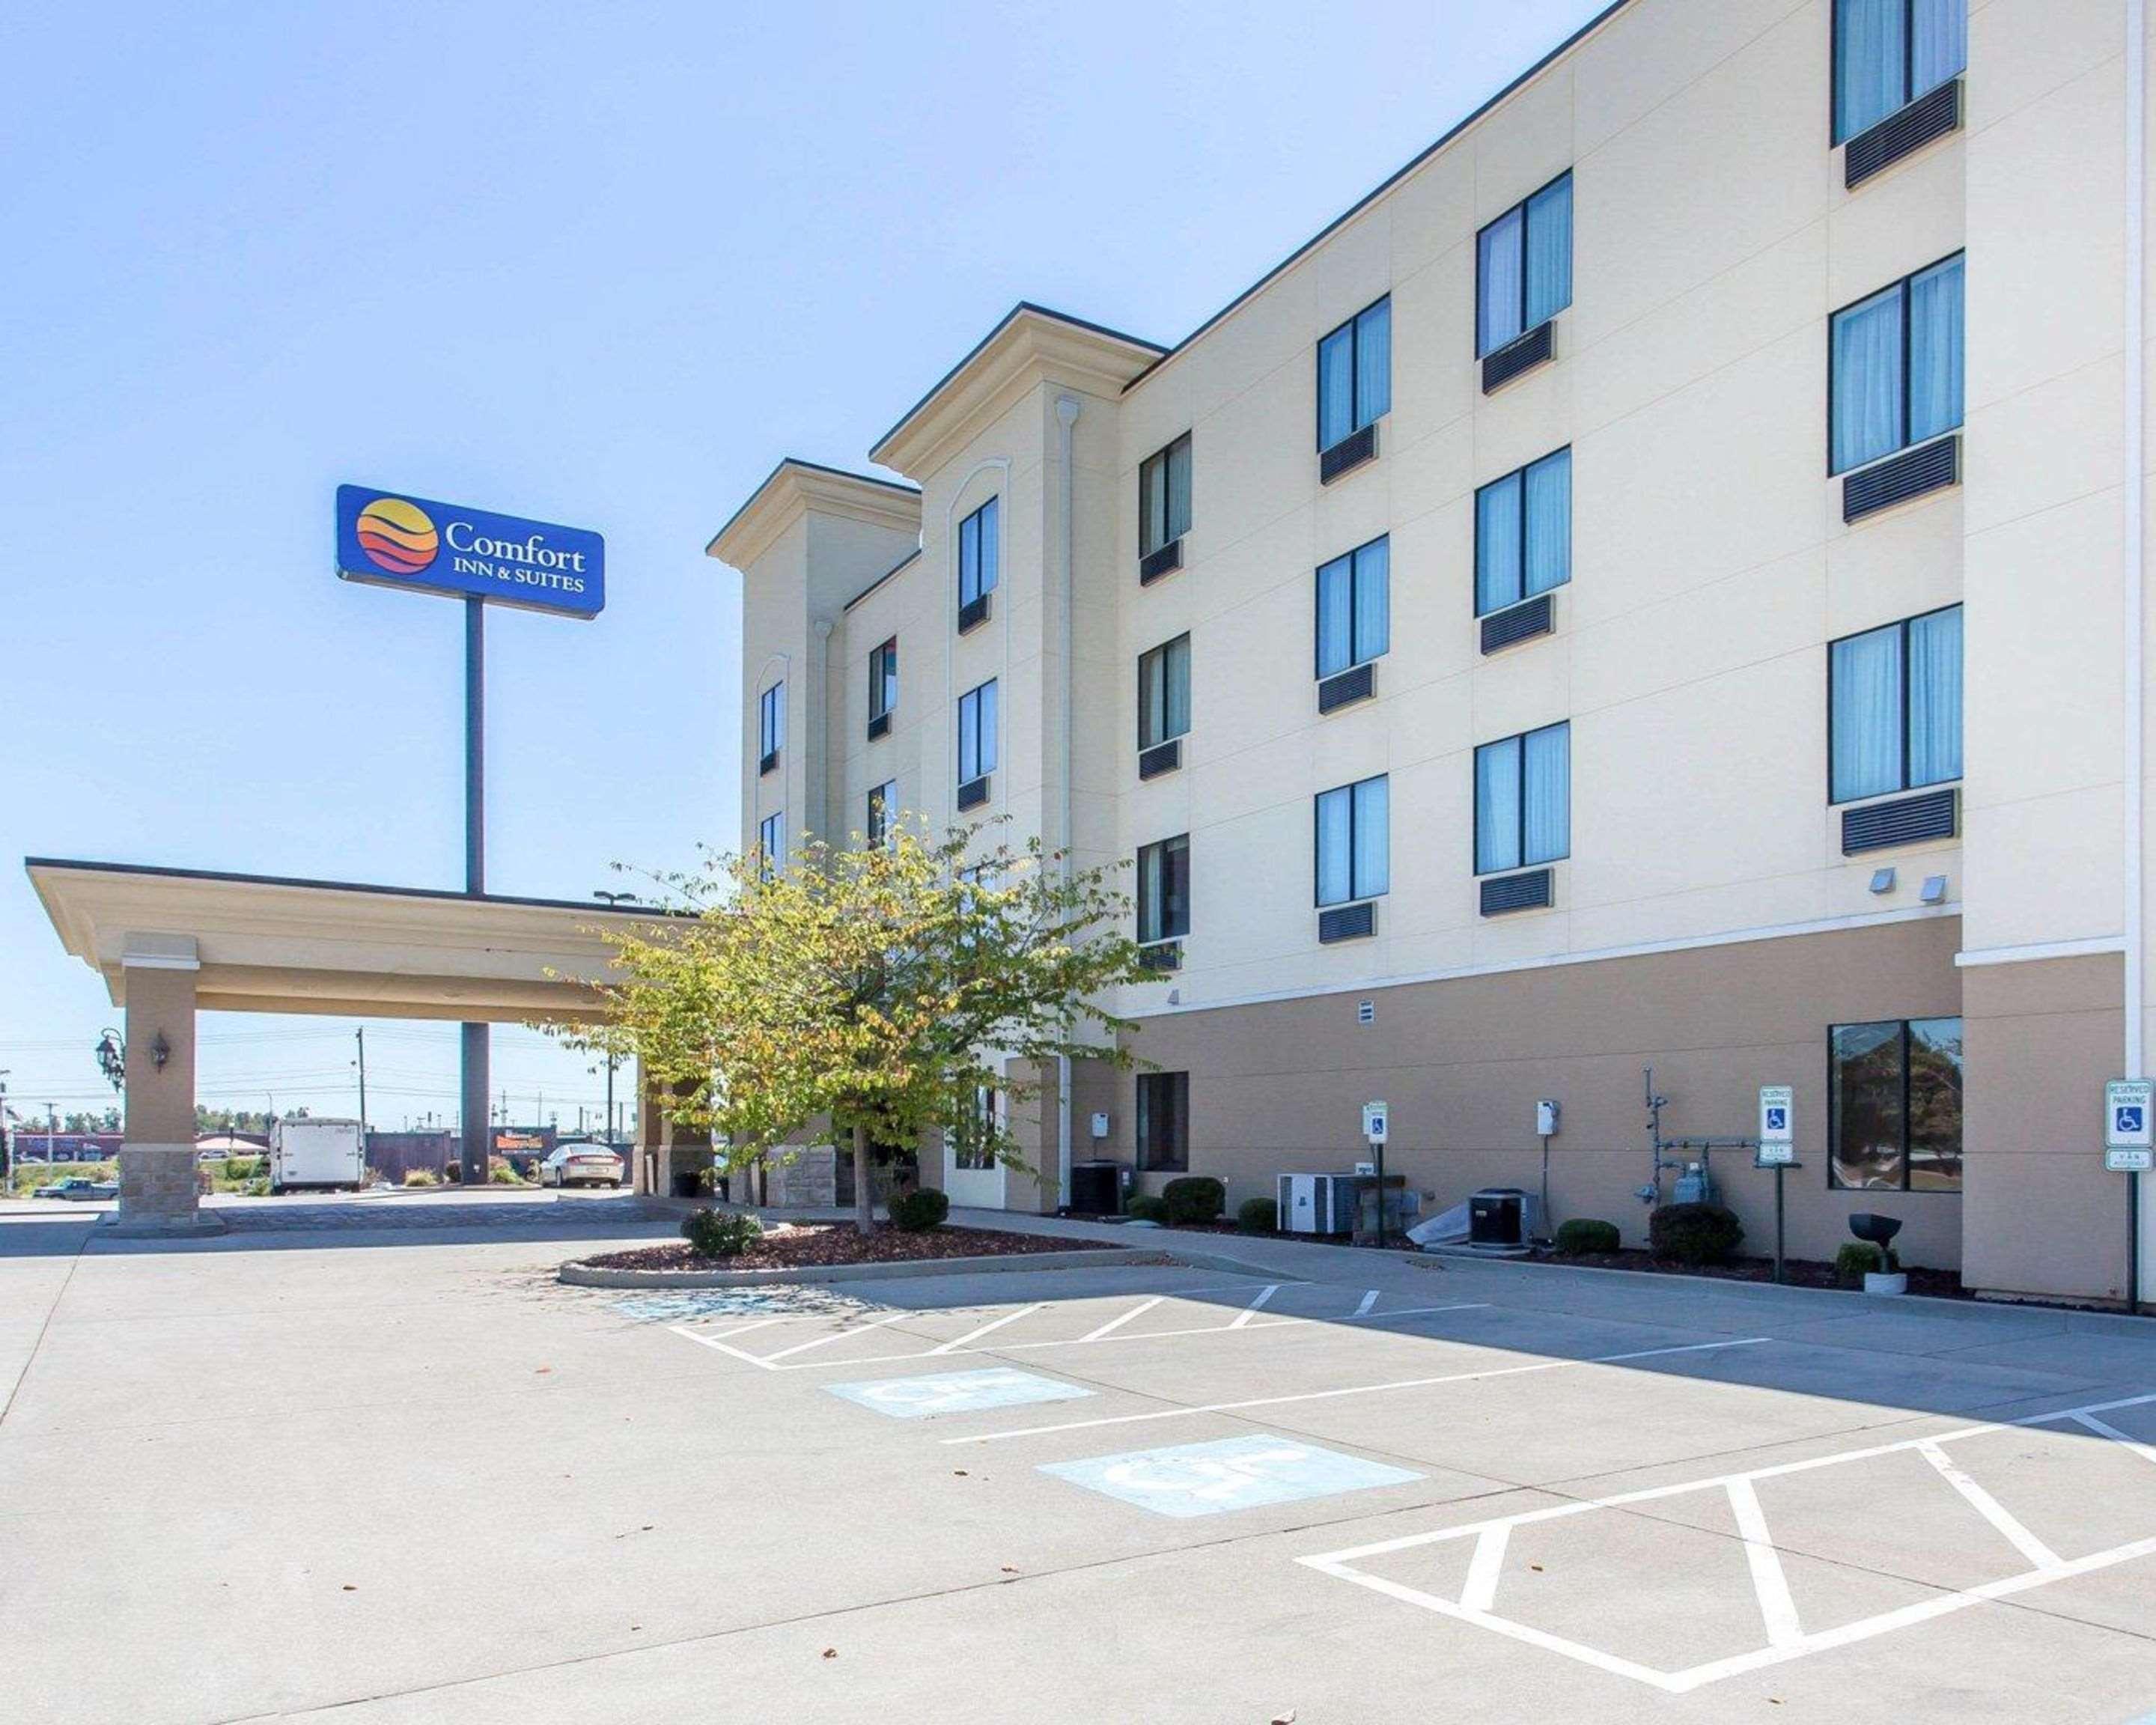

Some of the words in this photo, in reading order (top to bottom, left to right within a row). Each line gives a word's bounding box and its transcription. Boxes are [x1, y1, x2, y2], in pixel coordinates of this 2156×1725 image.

[445, 522, 585, 572] Comfort
[454, 556, 493, 577] INN
[498, 566, 511, 581] &
[515, 568, 585, 593] SUITES
[2113, 1095, 2146, 1103] PARKING
